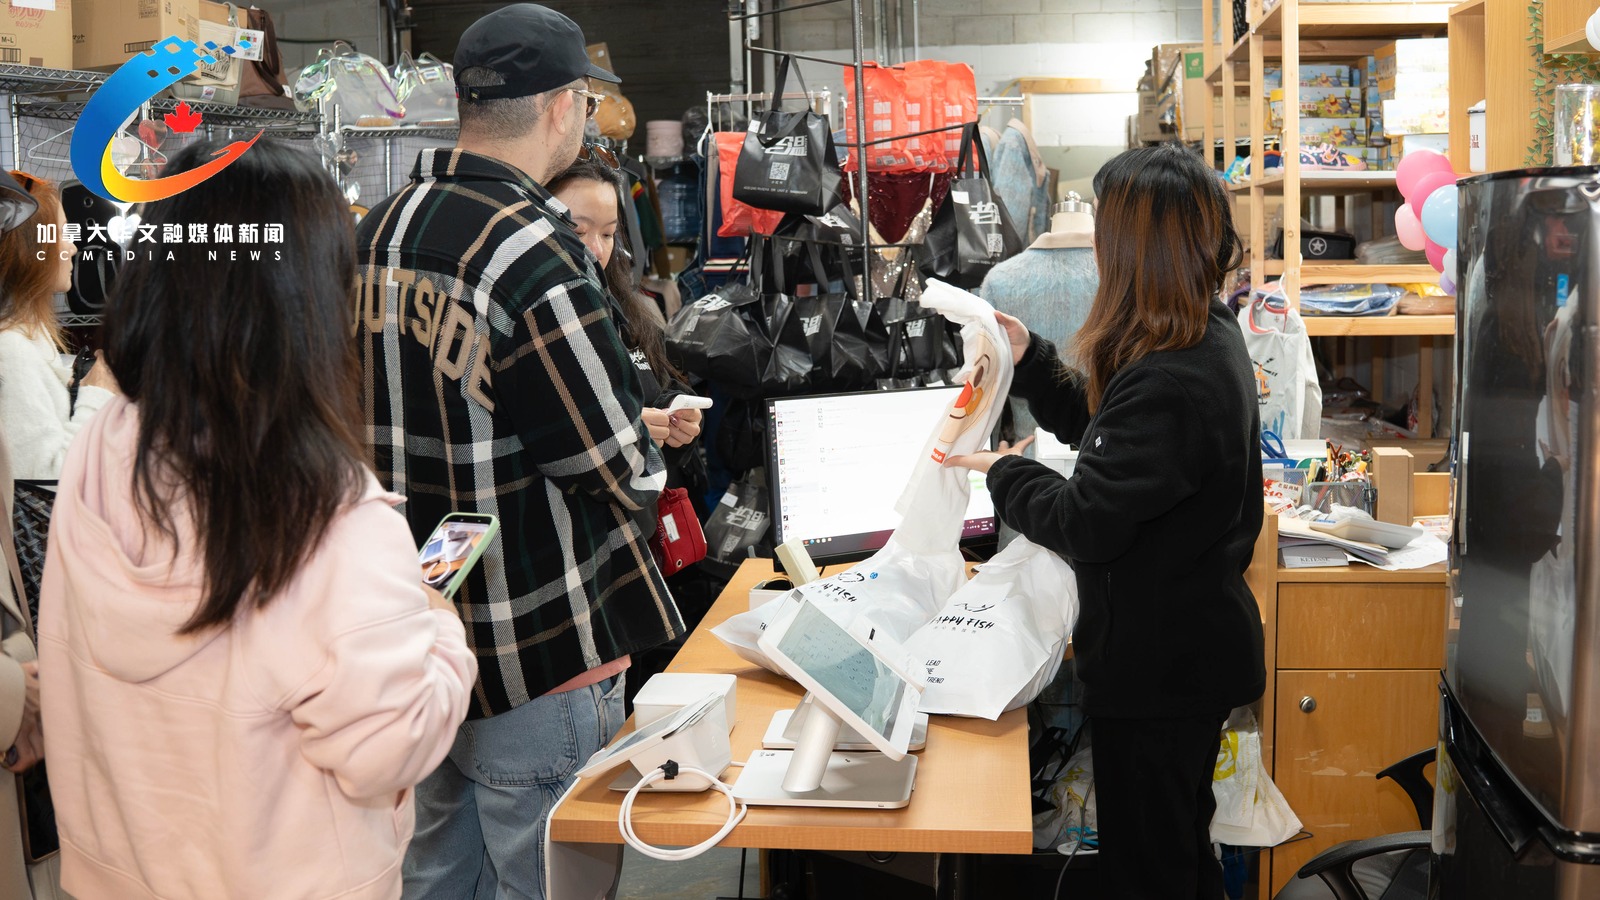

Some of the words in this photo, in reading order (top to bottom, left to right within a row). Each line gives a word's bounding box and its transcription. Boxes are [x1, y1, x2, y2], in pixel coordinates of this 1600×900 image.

[929, 615, 965, 626] APPY
[966, 618, 995, 630] FISH
[925, 659, 942, 667] LEAD
